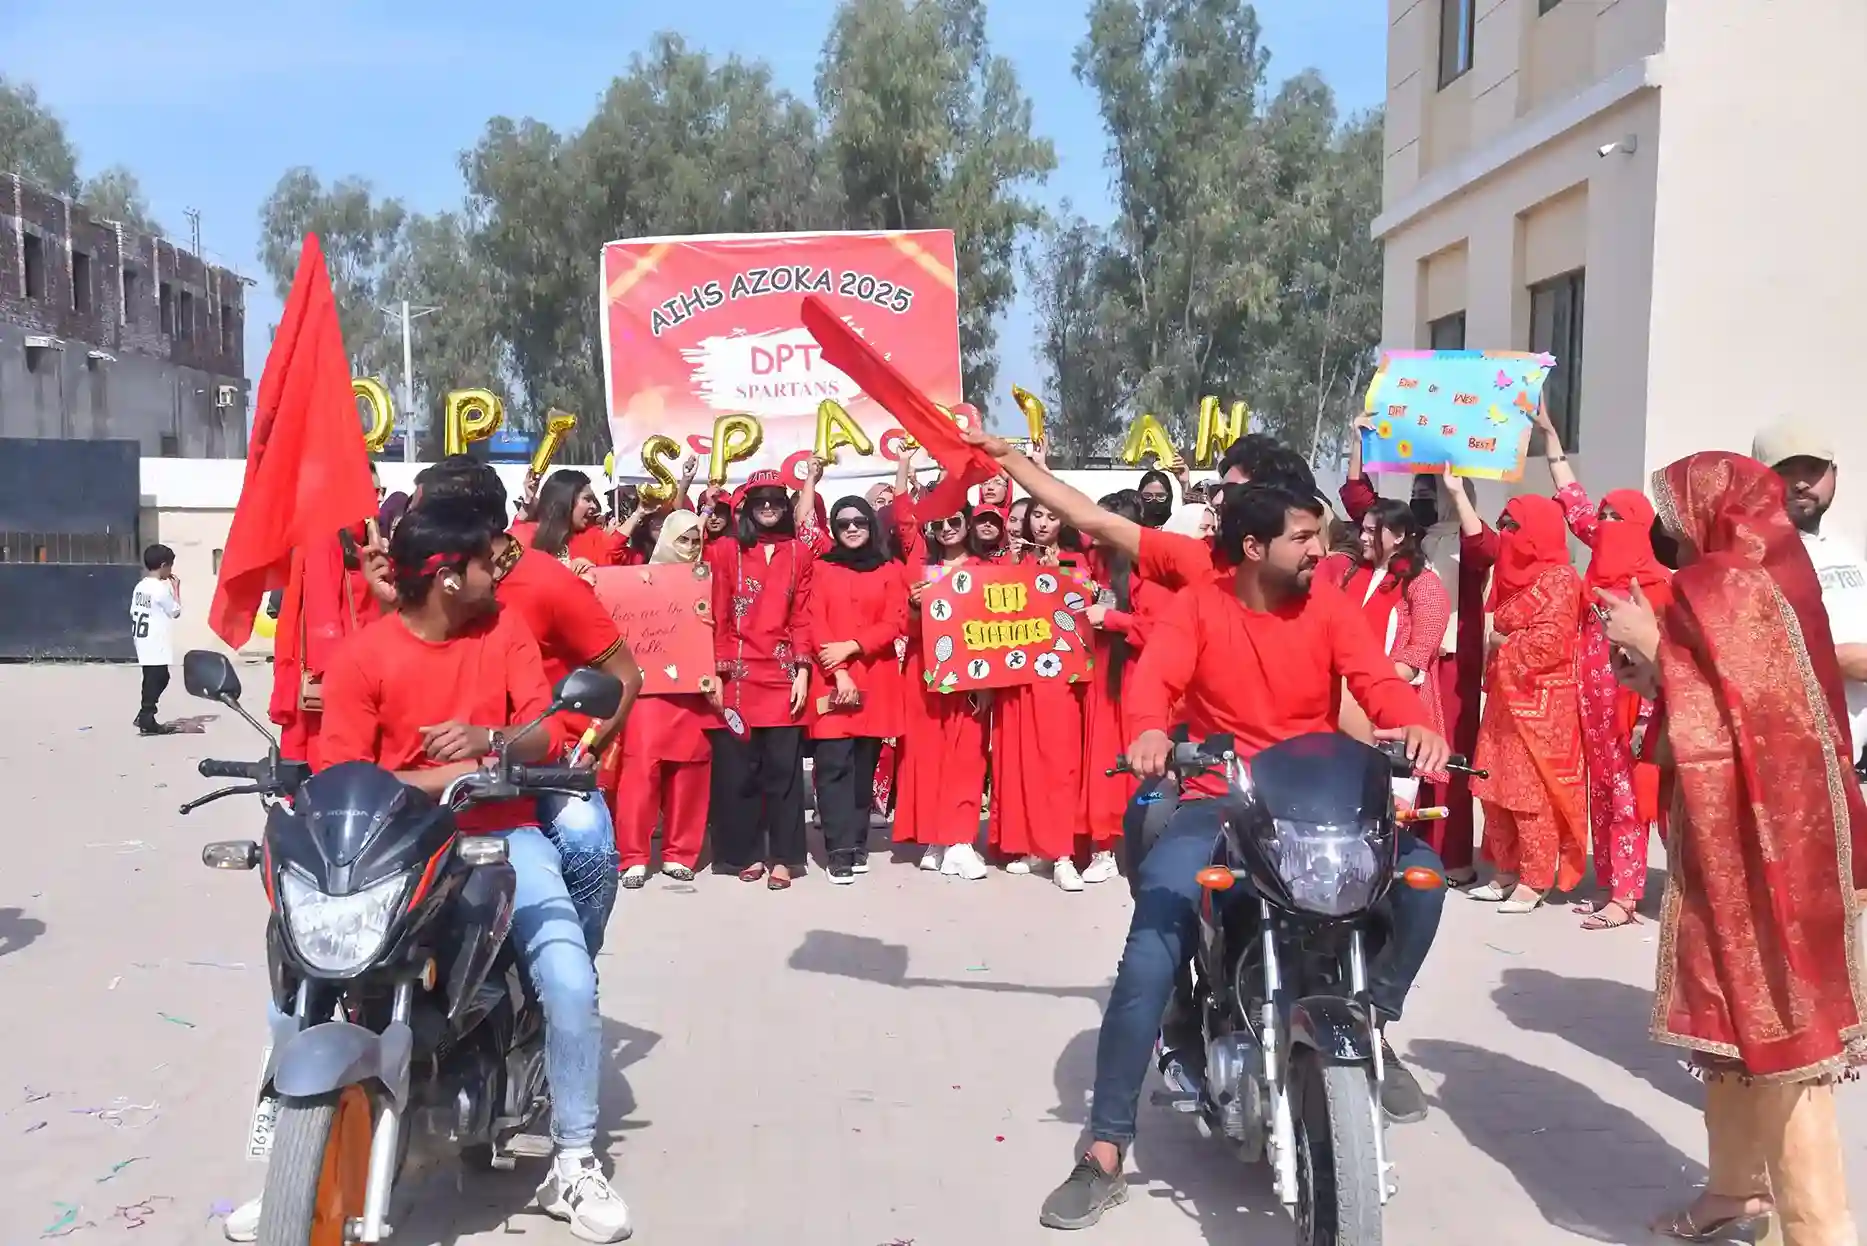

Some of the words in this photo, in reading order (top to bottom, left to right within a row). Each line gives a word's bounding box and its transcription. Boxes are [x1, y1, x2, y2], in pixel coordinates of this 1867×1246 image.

[650, 281, 725, 336] AIHS
[731, 267, 833, 299] AZOKA
[839, 271, 913, 313] 2025
[751, 344, 820, 375] DPT
[734, 381, 840, 399] SPARTANS
[987, 586, 1020, 609] DPT
[326, 808, 370, 817] HONDA
